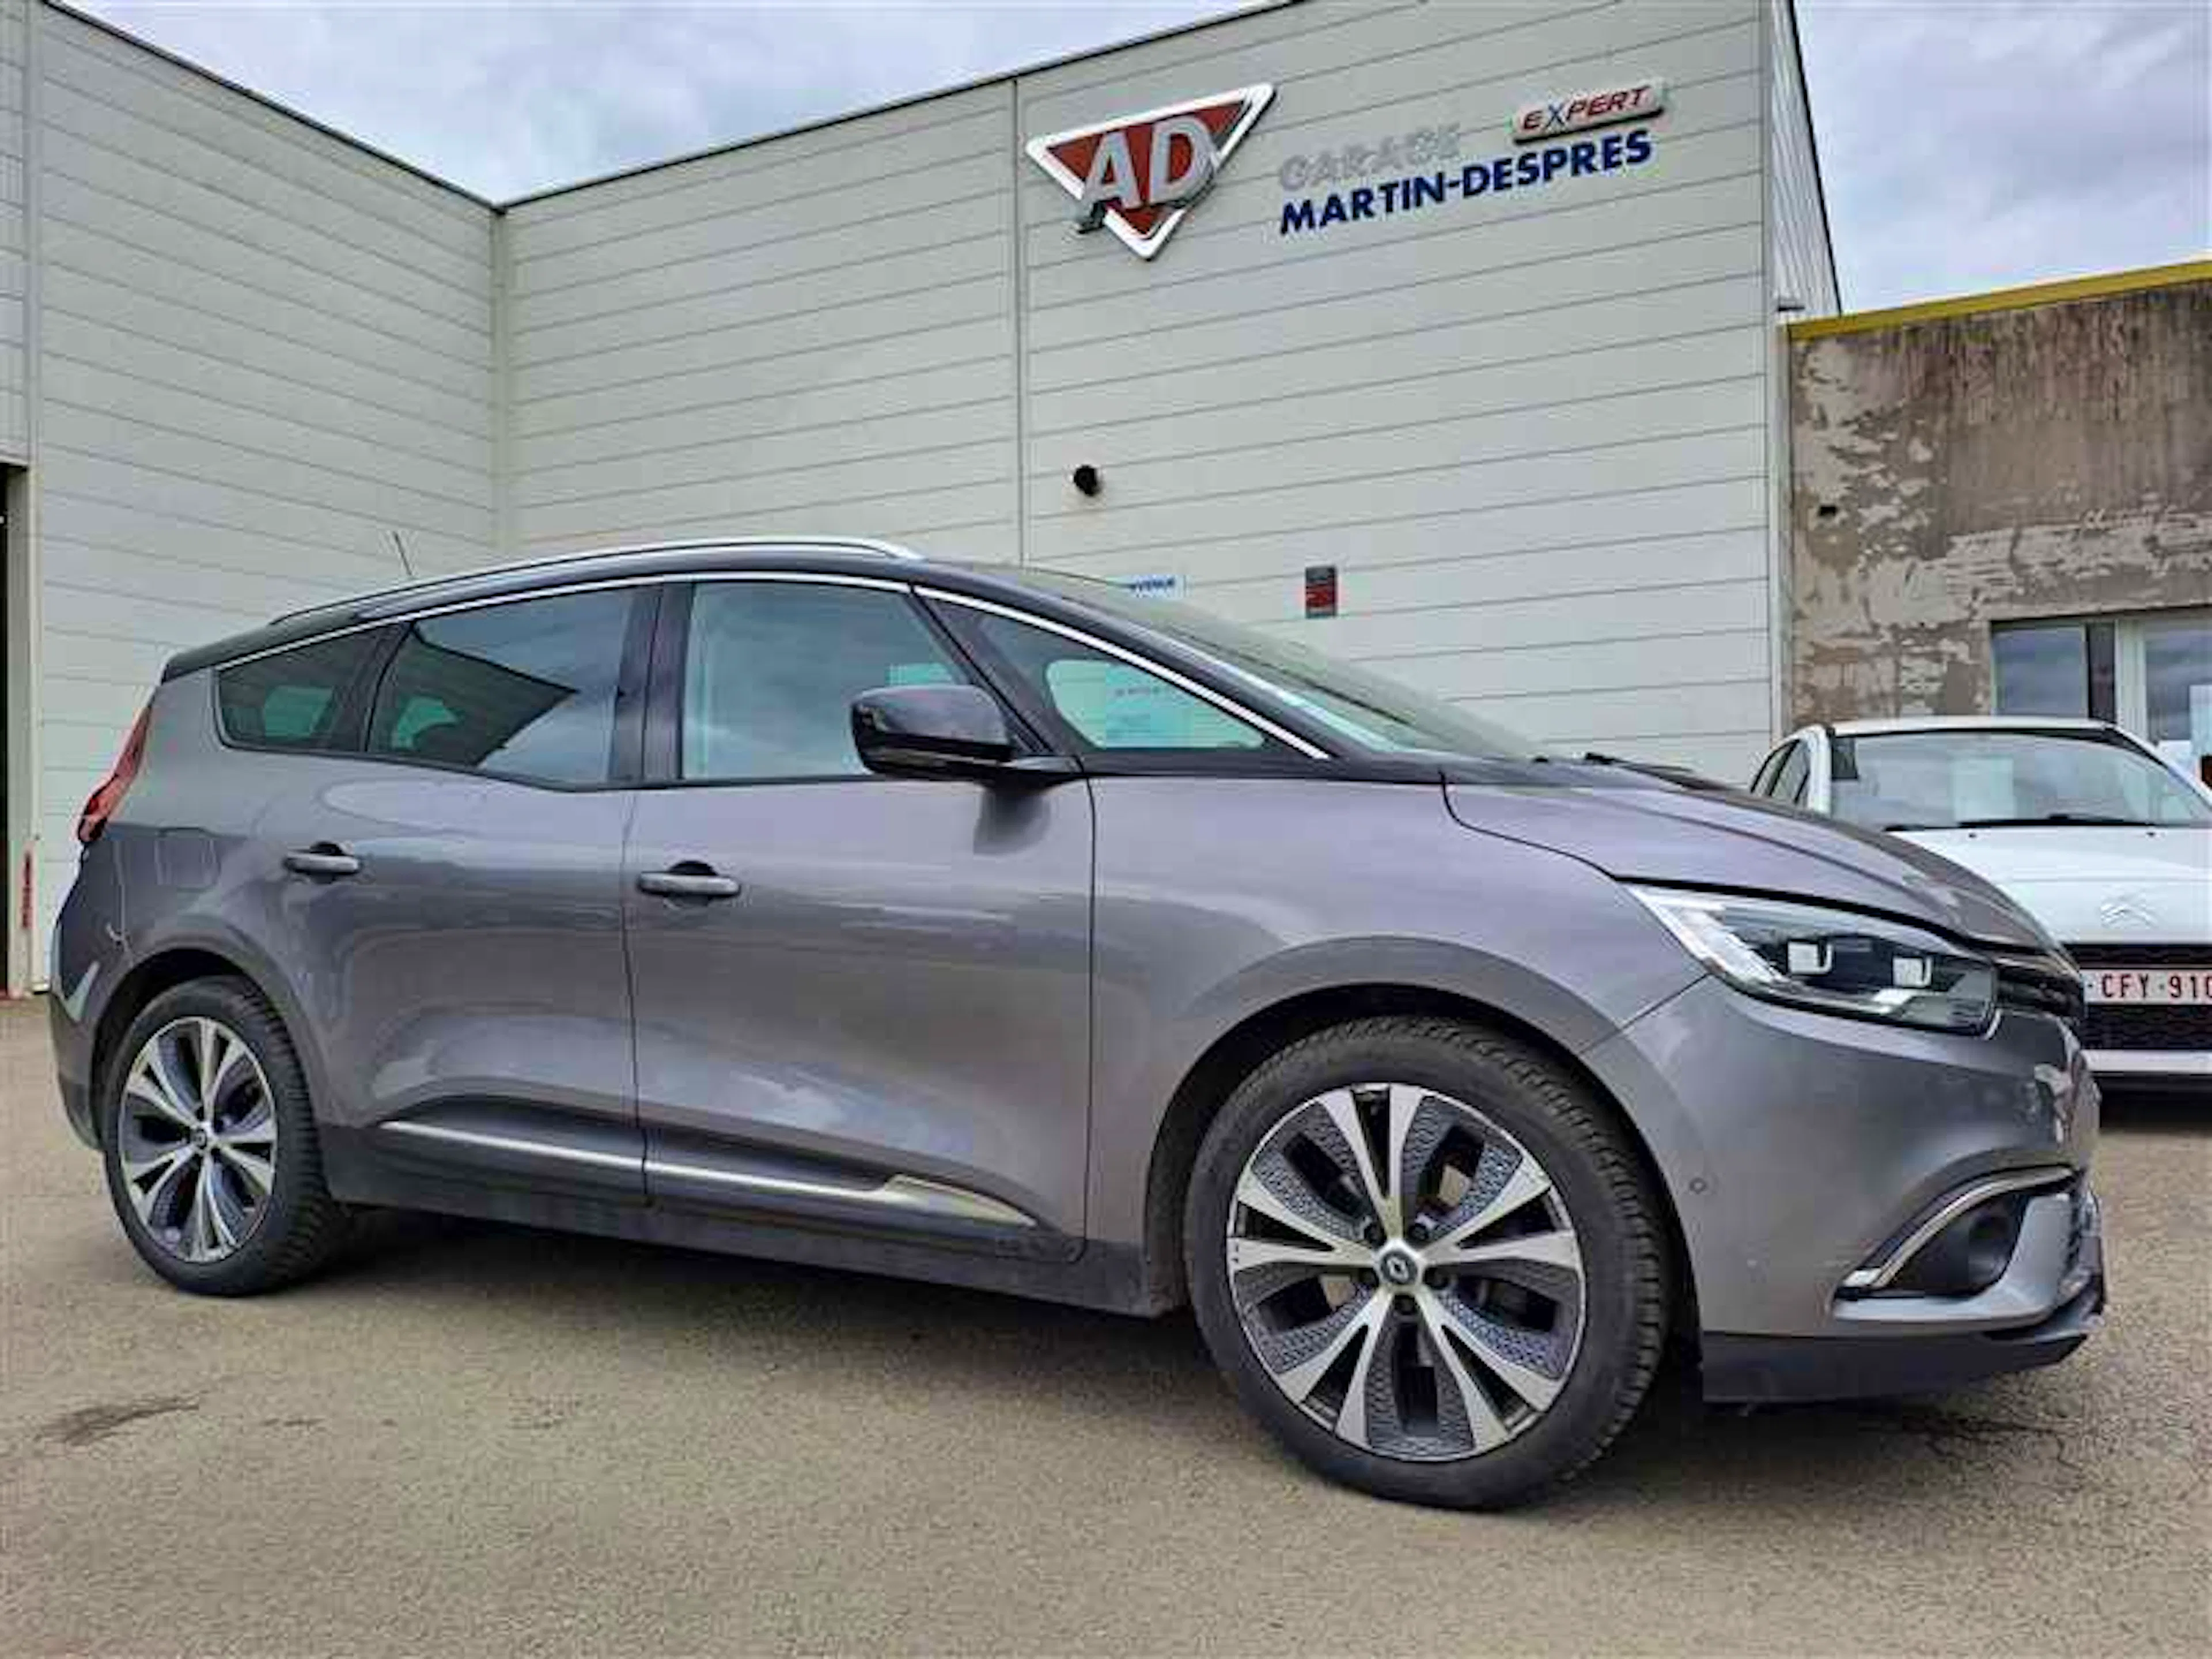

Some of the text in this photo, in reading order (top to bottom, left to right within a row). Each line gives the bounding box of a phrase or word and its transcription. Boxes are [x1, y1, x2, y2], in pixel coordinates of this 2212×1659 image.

[1523, 85, 1652, 130] EXPERT
[1076, 117, 1215, 225] AD
[1281, 128, 1652, 235] MARTIN-DESPRES
